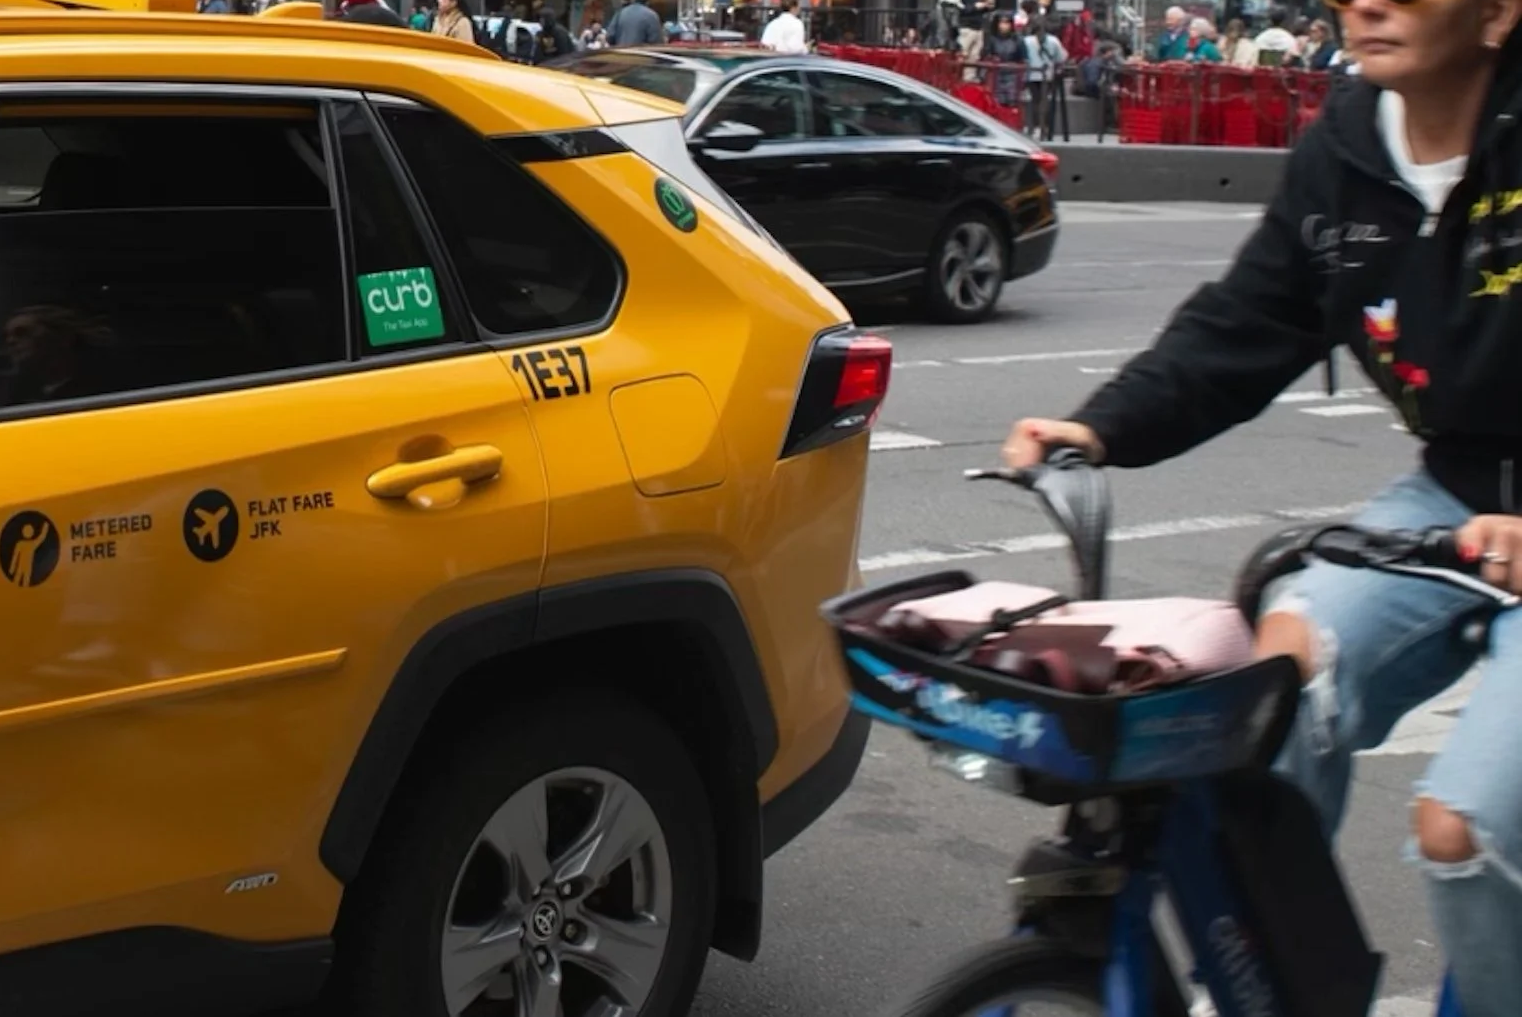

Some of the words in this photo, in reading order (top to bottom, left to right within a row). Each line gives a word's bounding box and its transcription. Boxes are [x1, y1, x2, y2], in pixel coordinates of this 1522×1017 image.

[367, 279, 433, 314] curb
[511, 344, 592, 402] 1E37
[247, 497, 288, 518] FLAT
[292, 491, 335, 513] FARE
[69, 514, 153, 541] METERED
[248, 519, 282, 541] JFK
[70, 540, 118, 564] FARE
